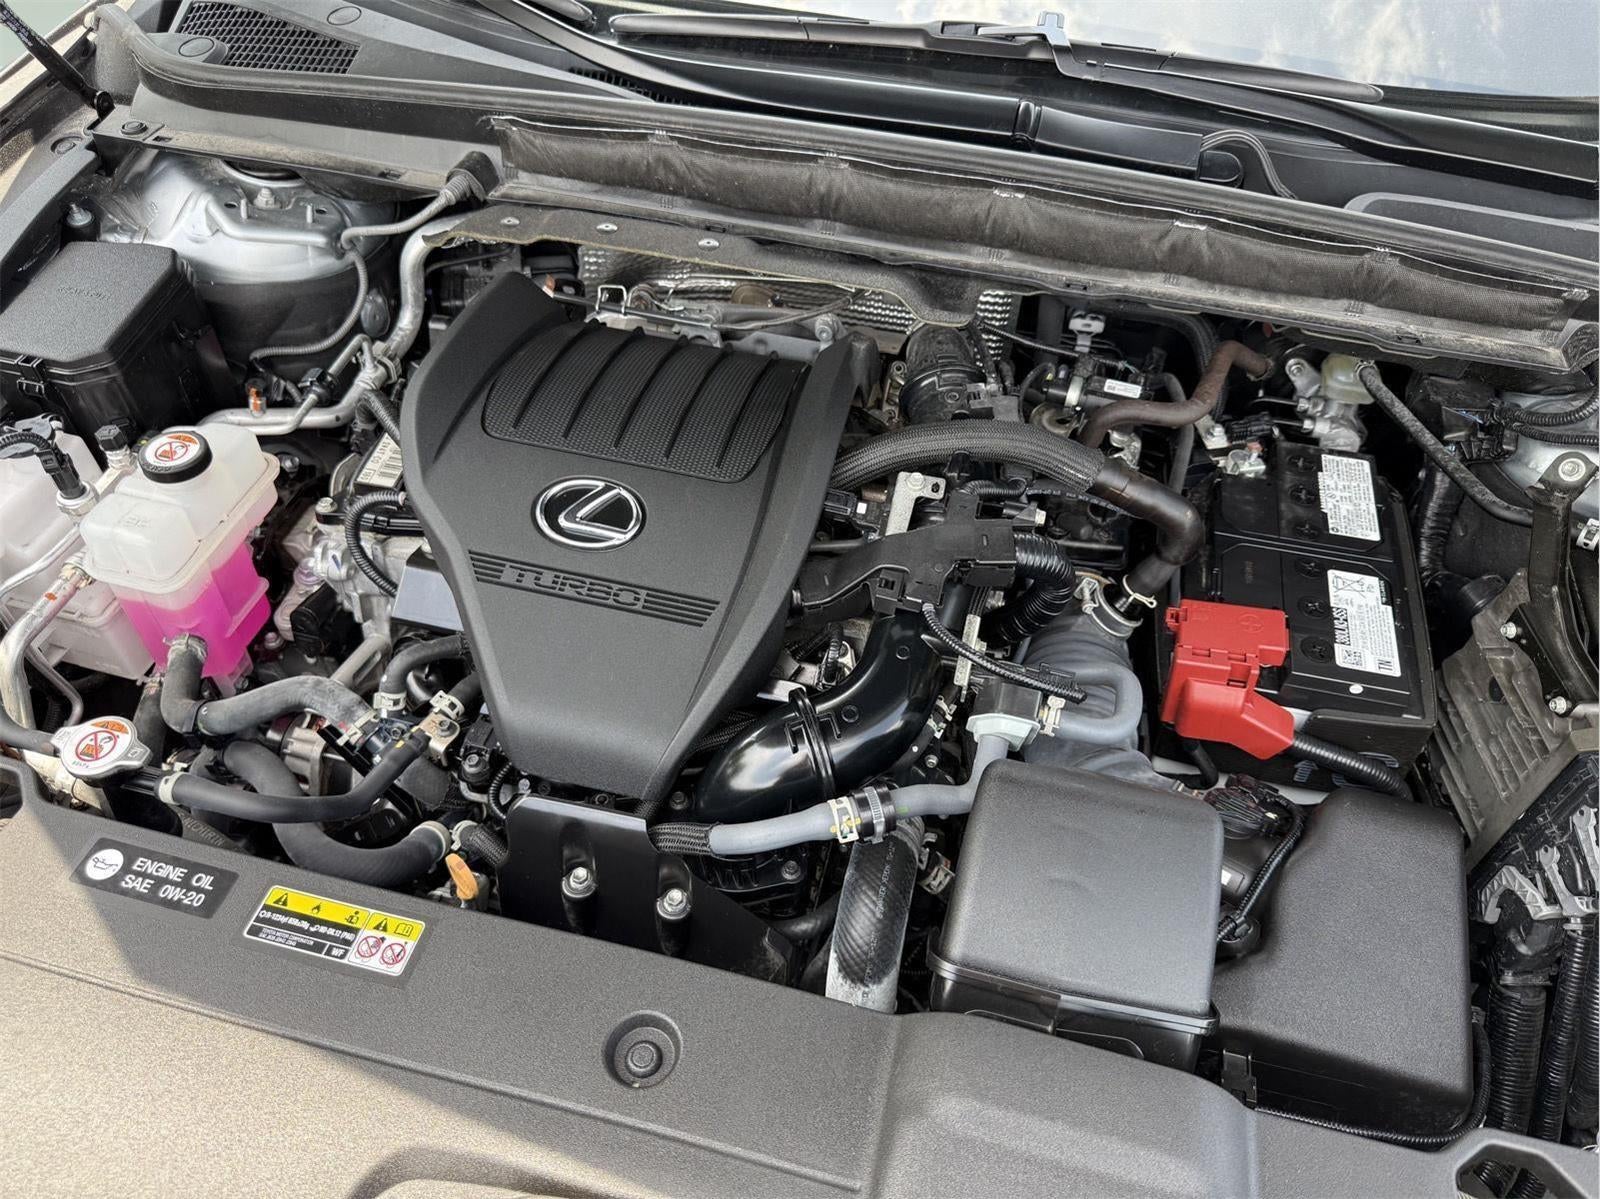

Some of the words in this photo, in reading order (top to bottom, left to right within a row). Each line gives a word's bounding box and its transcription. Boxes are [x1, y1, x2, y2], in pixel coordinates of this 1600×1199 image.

[504, 563, 644, 607] TURBO
[131, 857, 188, 882] ENGINE
[191, 873, 215, 890] OIL
[121, 874, 155, 893] SAE
[159, 884, 205, 907] 0W-20
[331, 947, 346, 957] WF
